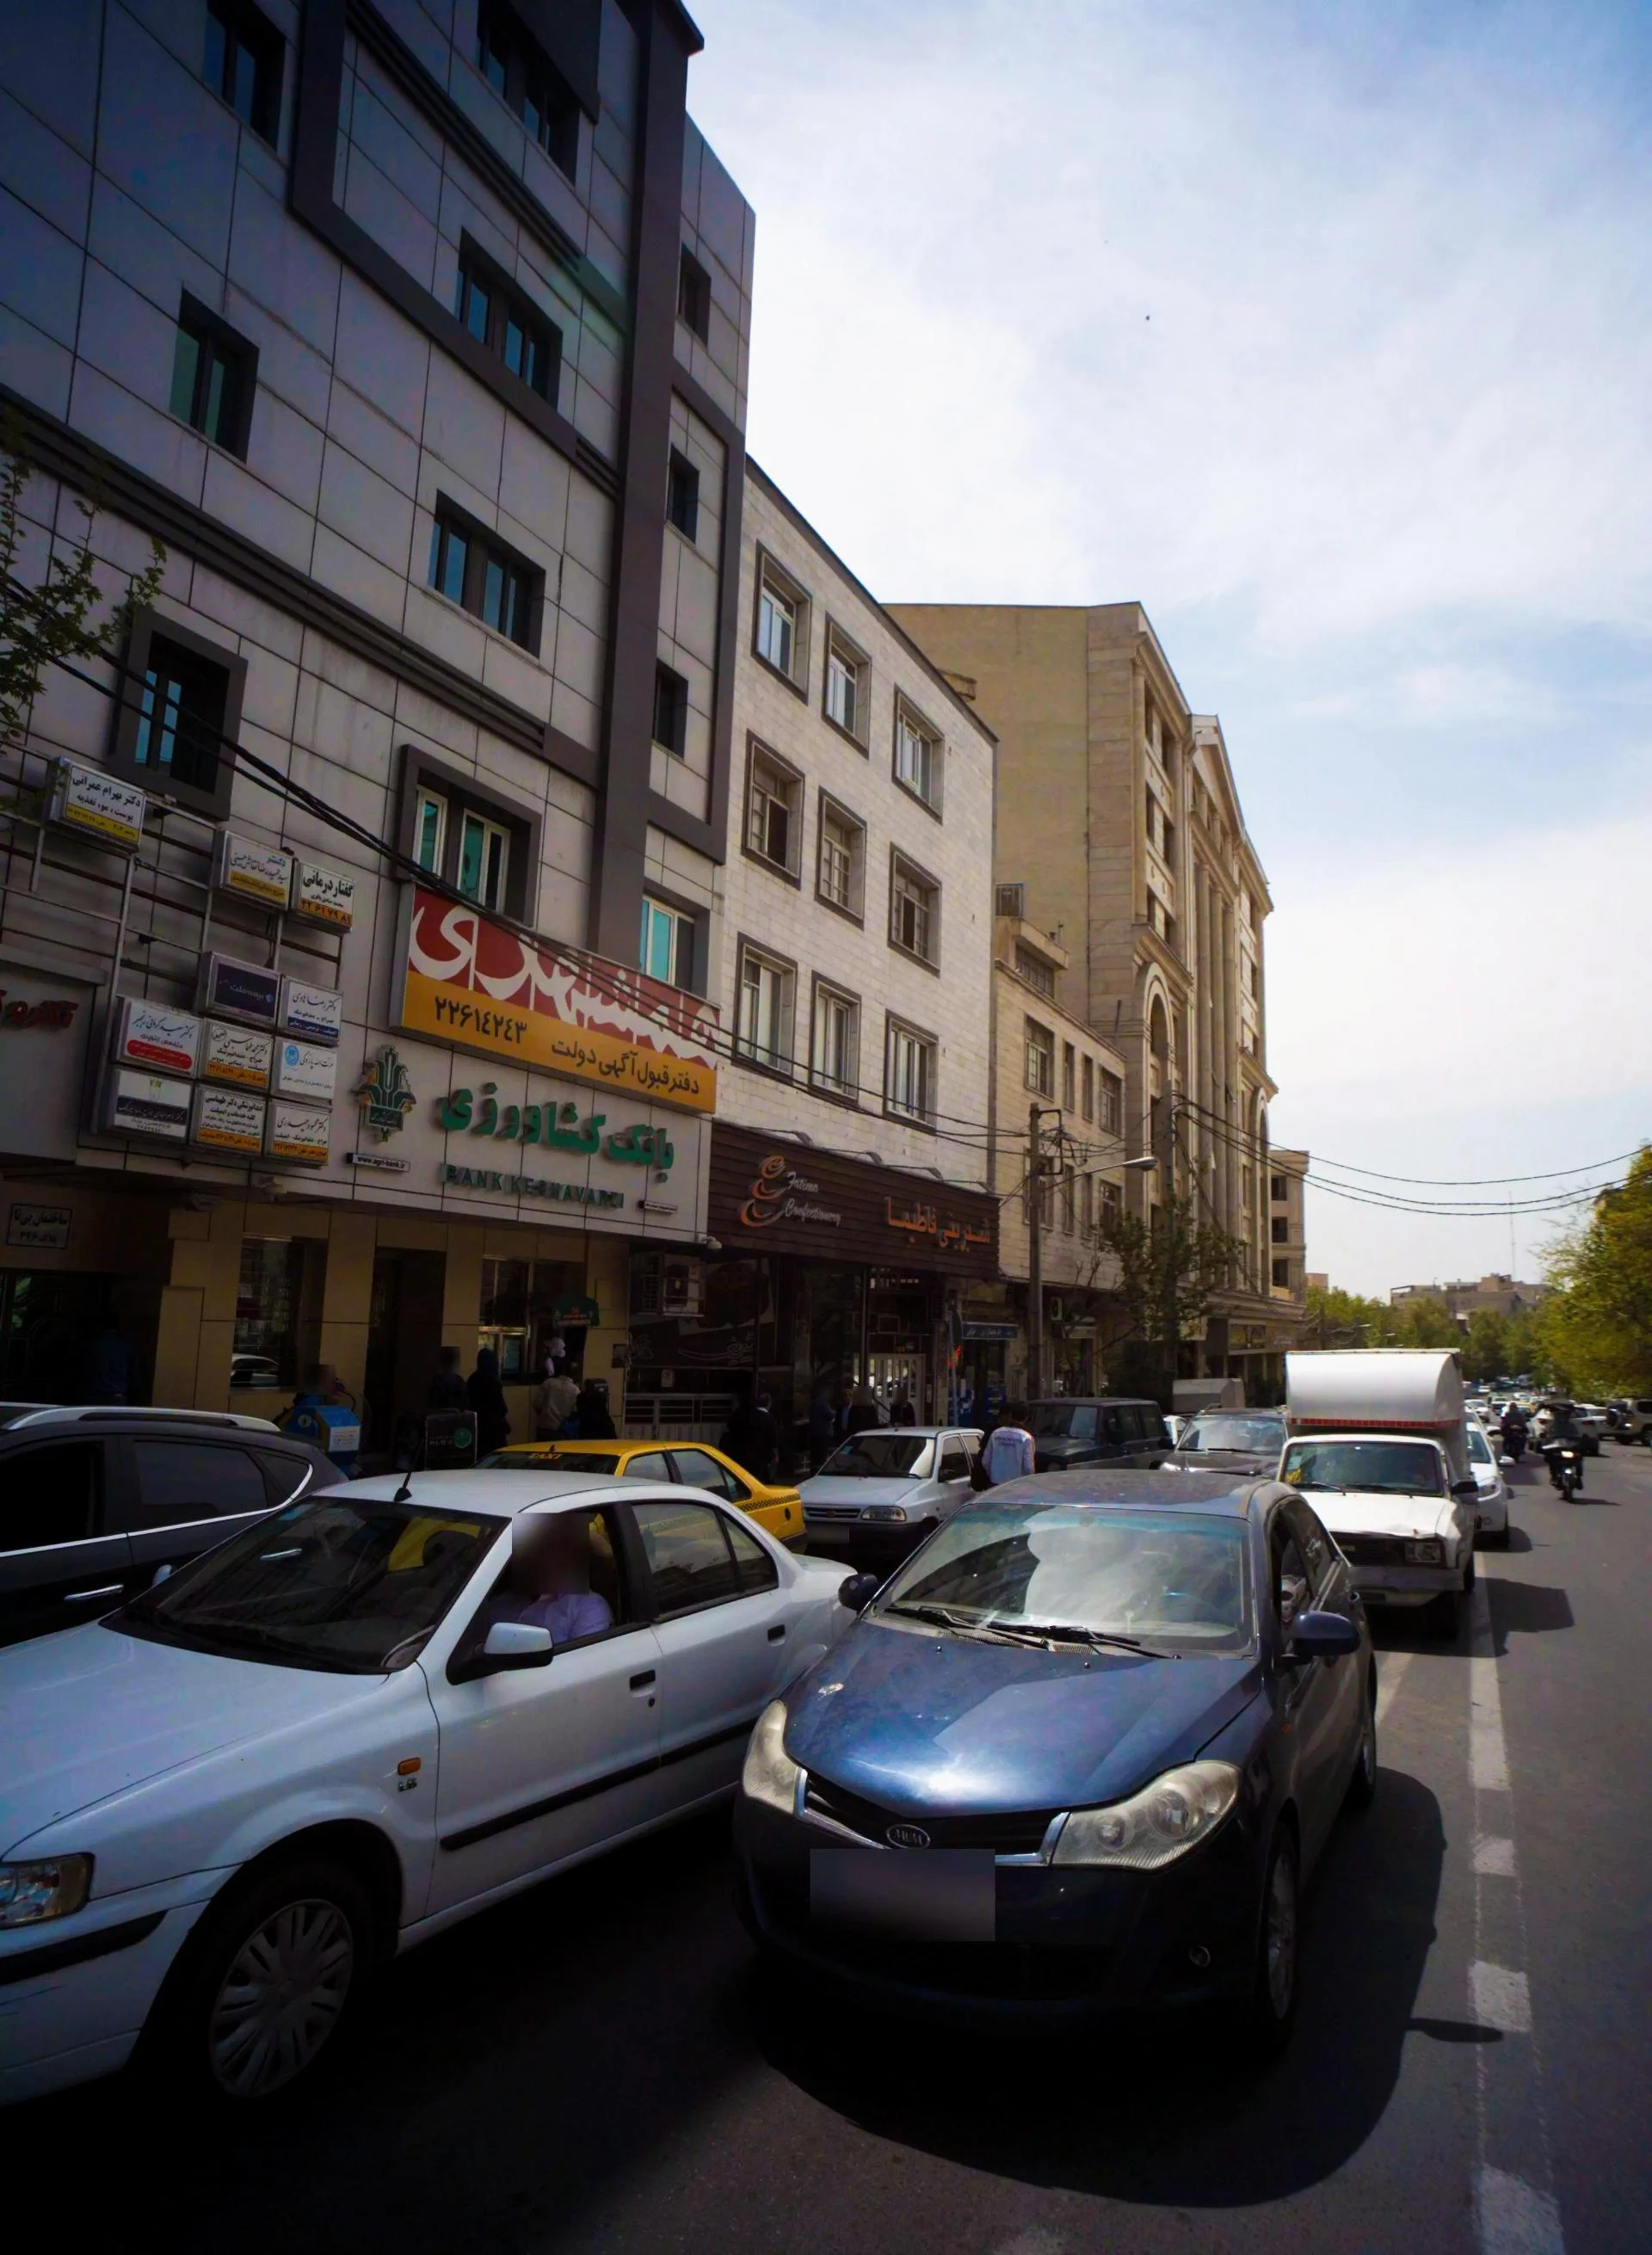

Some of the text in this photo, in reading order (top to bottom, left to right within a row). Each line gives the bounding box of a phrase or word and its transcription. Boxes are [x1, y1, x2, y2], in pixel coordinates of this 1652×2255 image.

[102, 786, 122, 802] بهرام
[123, 795, 141, 808] دکتر
[303, 870, 334, 894] درمانی
[332, 879, 353, 898] گفتار
[551, 1039, 700, 1100] دفتر قبول آگهی دولت
[440, 1081, 675, 1184] بانک کشاورزی
[441, 1162, 626, 1209] BANK KESHAVARZI
[786, 1170, 819, 1193] Fatima
[885, 1195, 991, 1253] شیرینی فاطیما
